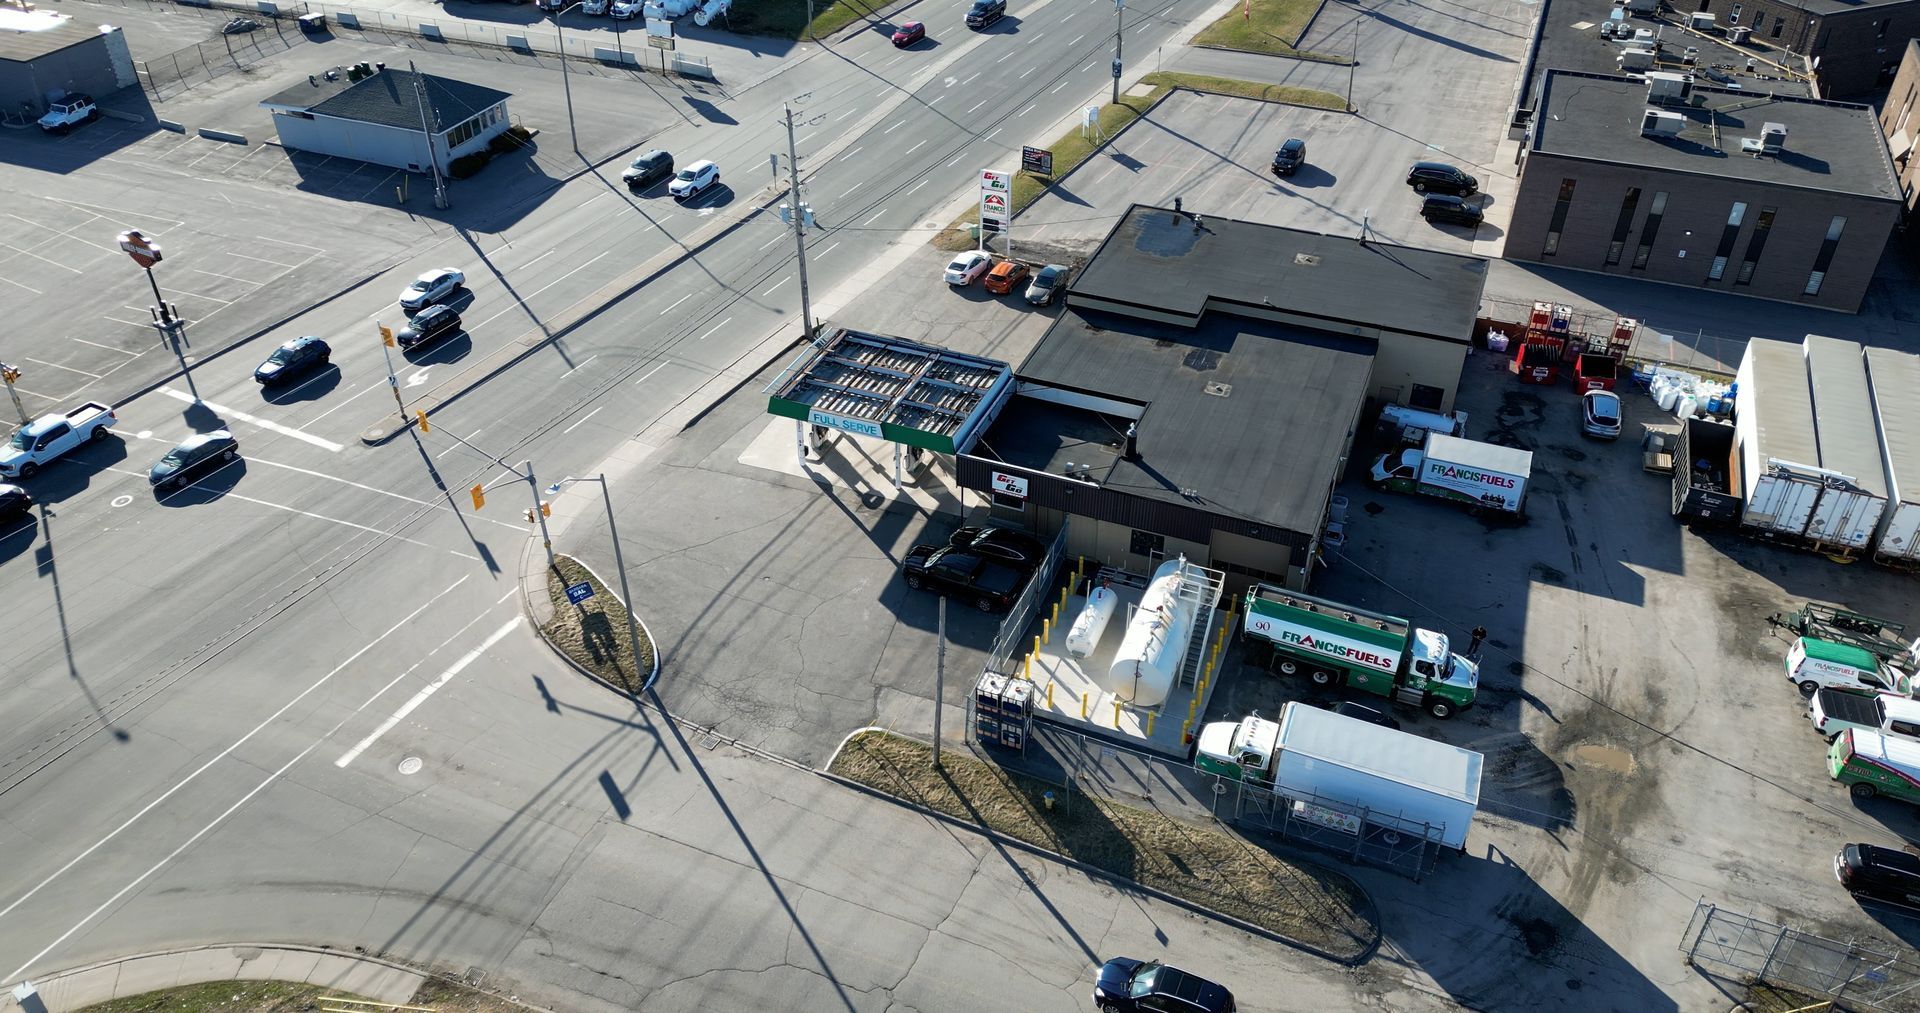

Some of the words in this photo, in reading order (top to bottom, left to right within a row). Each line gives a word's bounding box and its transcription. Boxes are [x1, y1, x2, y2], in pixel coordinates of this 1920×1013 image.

[813, 413, 839, 427] FULL
[842, 420, 877, 435] SERVE
[1255, 621, 1271, 631] 90
